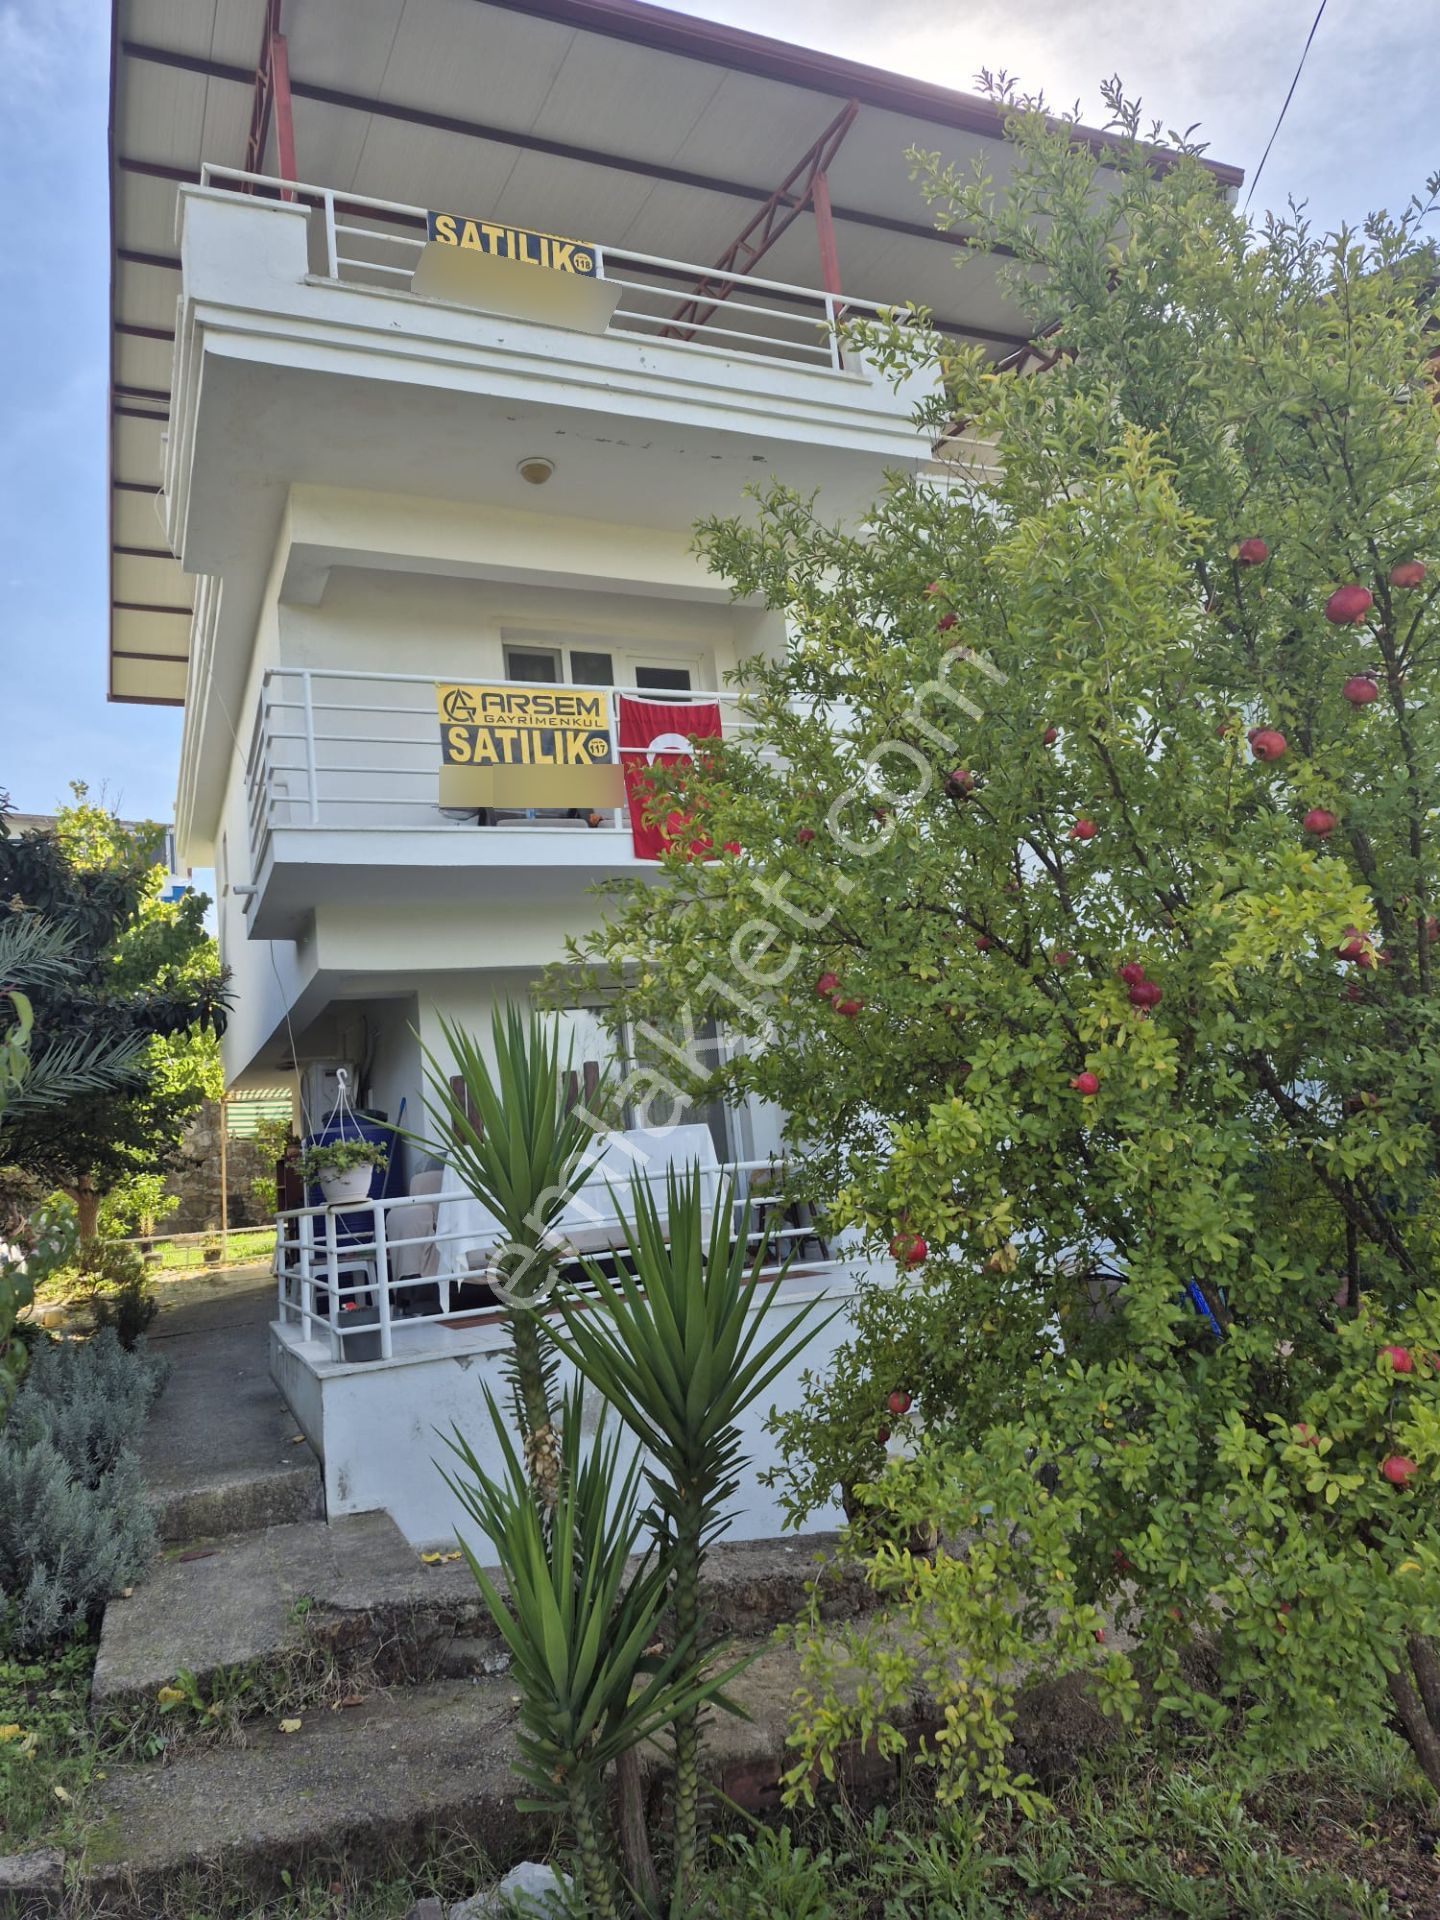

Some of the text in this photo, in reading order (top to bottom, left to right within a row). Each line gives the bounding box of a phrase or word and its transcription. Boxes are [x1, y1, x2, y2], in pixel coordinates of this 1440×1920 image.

[435, 215, 575, 274] SATILIK
[480, 692, 600, 717] ARSEM
[484, 714, 603, 728] GAYRİMENKUL
[448, 726, 593, 764] SATILIK
